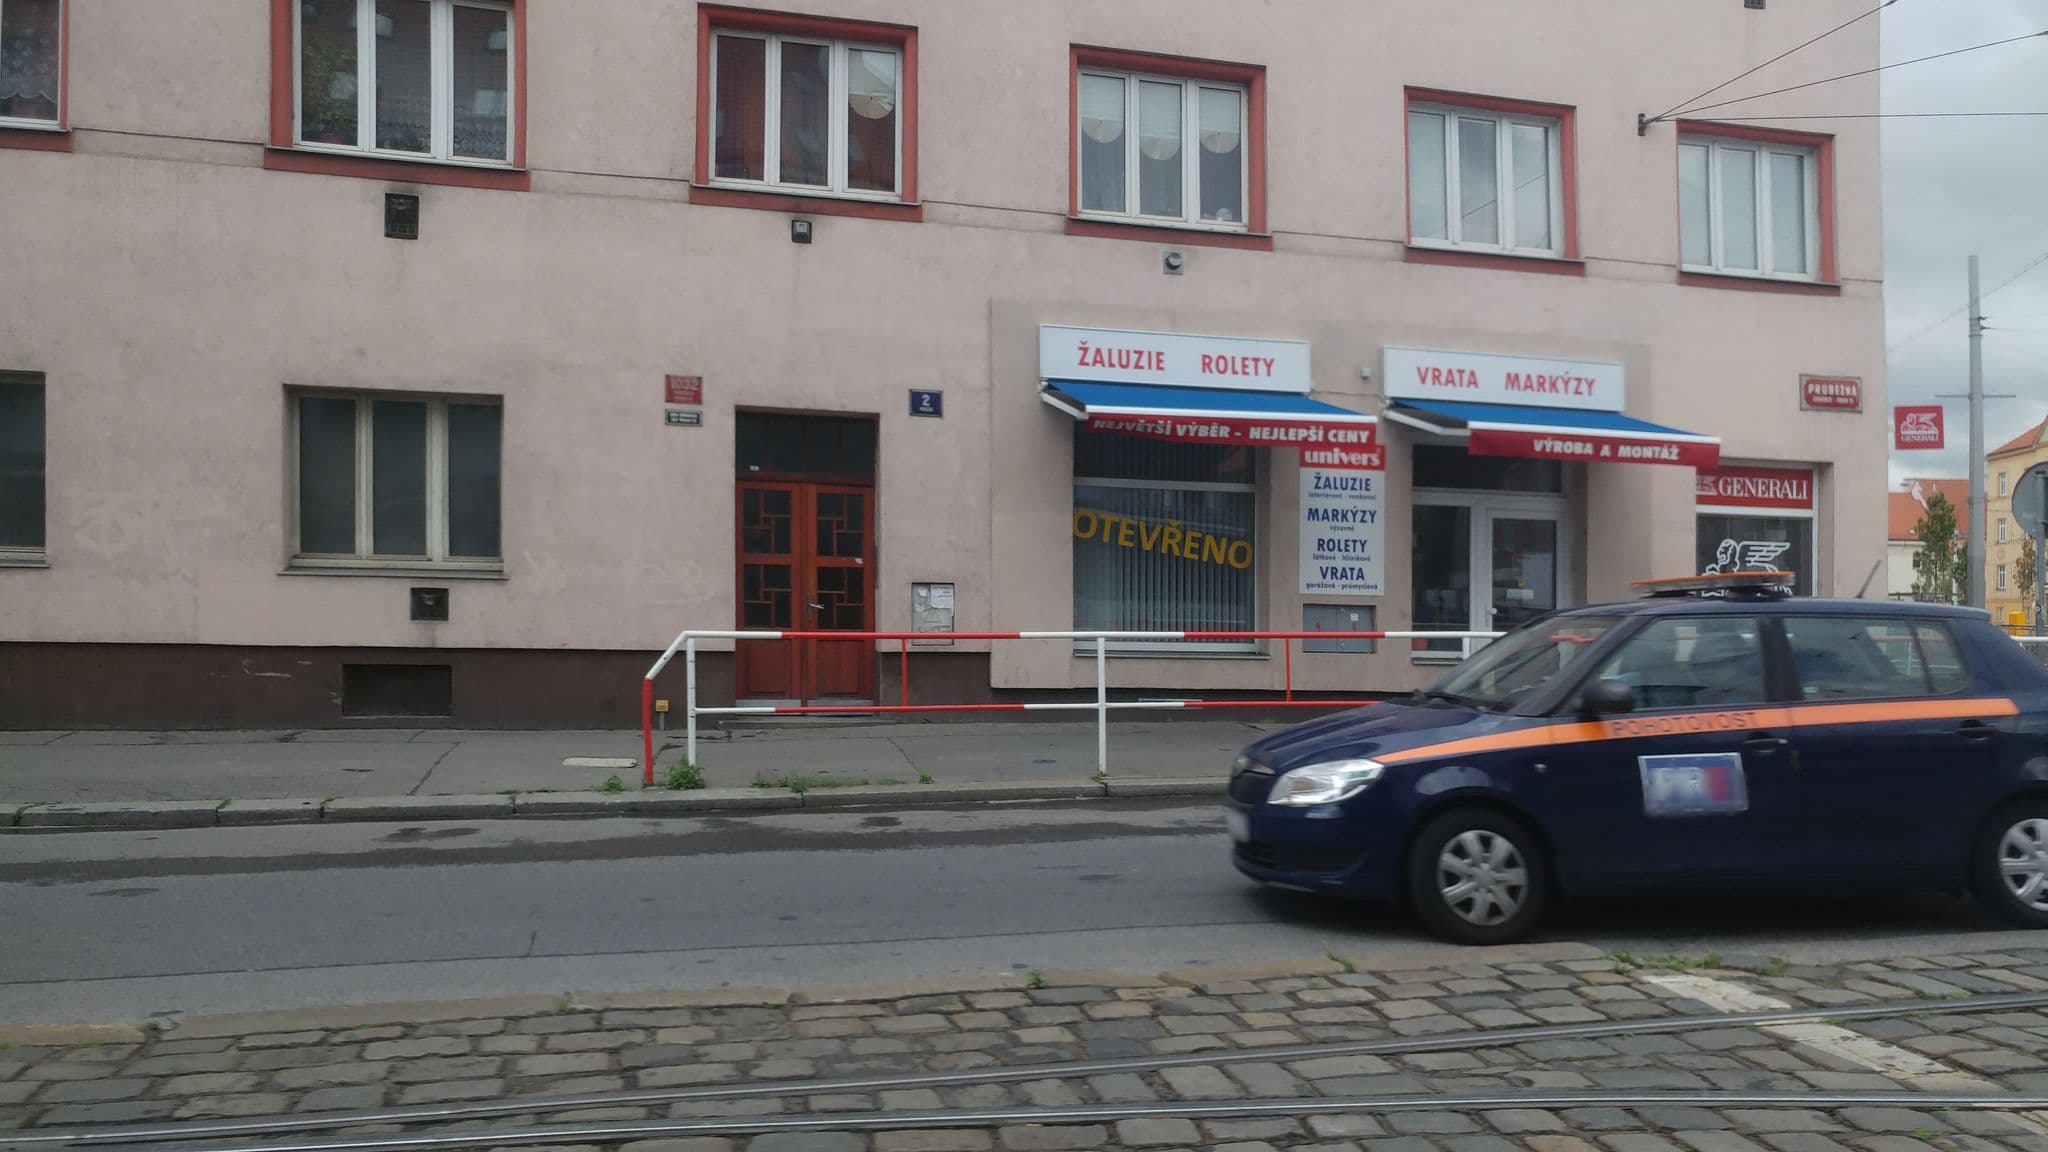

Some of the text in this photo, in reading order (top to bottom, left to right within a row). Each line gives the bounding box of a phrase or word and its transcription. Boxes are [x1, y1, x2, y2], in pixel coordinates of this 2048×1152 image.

[1078, 340, 1276, 377] ŽALUZIE ROLETY
[1417, 366, 1596, 397] VRATA MARKÝZY
[922, 394, 931, 406] 2
[1093, 419, 1172, 435] NEJVĚTŠÍ
[1176, 421, 1230, 438] VÝBĚR
[1249, 425, 1323, 443] NEJLEPŠÍ
[1328, 429, 1370, 443] CENY
[1901, 434, 1939, 442] GENERALI
[1304, 447, 1380, 467] univers
[1533, 437, 1680, 461] VÝROBA A MONTÁŽ
[1314, 472, 1372, 492] ŽALUZIE
[1718, 477, 1808, 501] GENERALI
[1307, 506, 1377, 523] MARKÝZY
[1073, 509, 1253, 570] OTEVŘENO
[1317, 538, 1368, 553] ROLETY
[1319, 566, 1365, 581] VRATA
